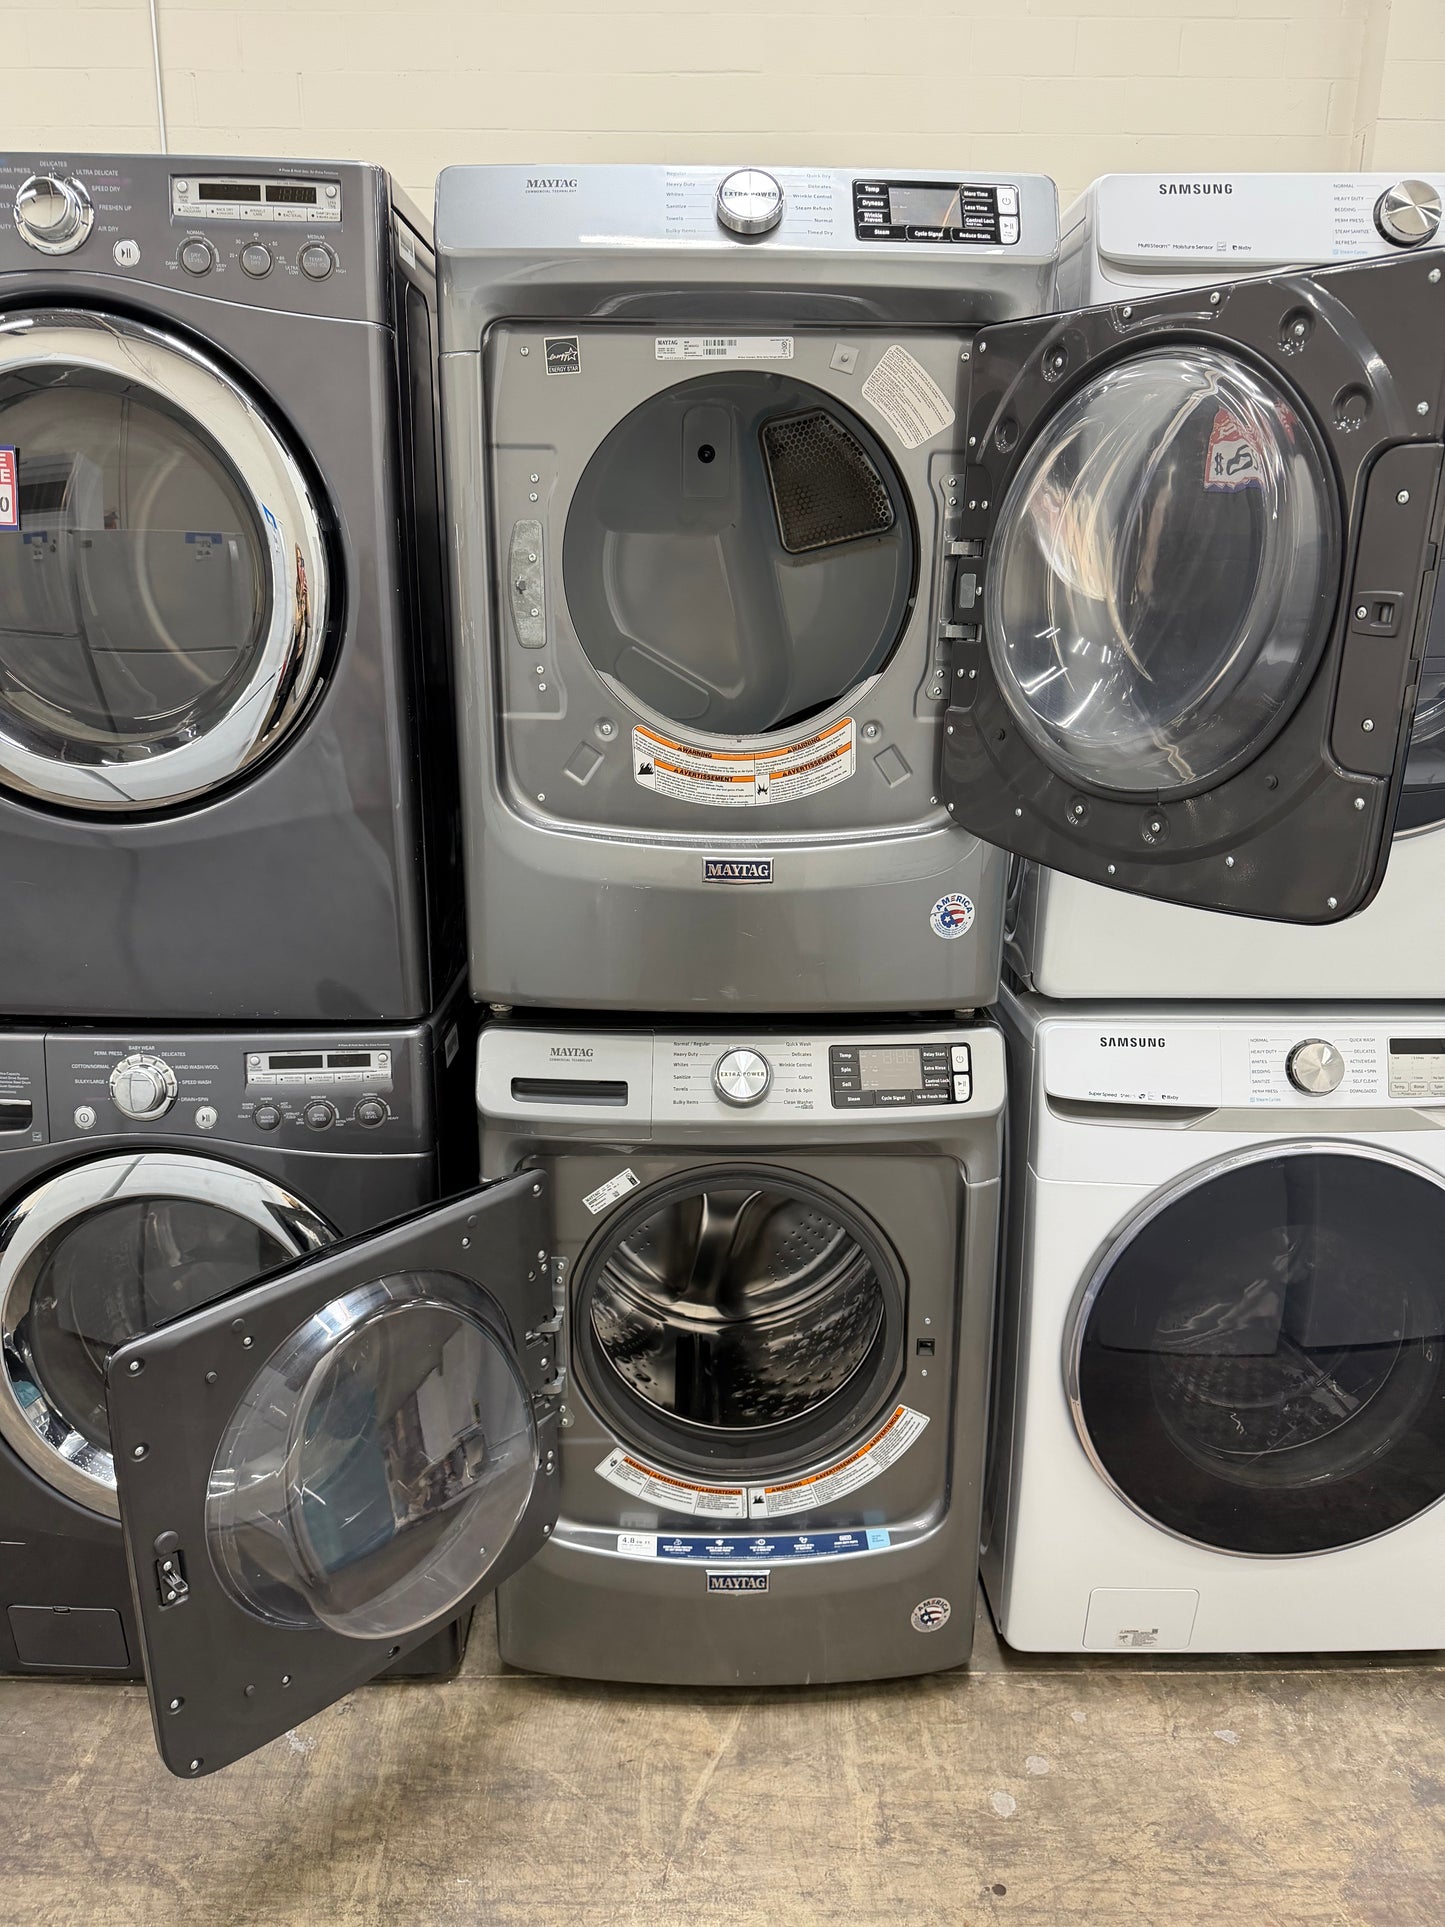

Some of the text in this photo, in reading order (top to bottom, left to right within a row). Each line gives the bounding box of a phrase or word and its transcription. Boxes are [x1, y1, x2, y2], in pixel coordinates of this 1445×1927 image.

[526, 179, 578, 188] MAYTAG
[1159, 183, 1233, 195] SAMSUNG
[914, 230, 943, 238] Cycle Signal
[791, 736, 821, 752] WARNING
[681, 746, 713, 759] WARNING
[787, 750, 839, 777] AVERTISSEMENT
[679, 769, 734, 783] AVERTISSEMENT
[707, 863, 769, 877] MAYTAG
[936, 895, 973, 914] AMERICA
[1100, 1037, 1166, 1048] SAMSUNG
[550, 1047, 594, 1057] MAYTAG
[705, 1487, 742, 1496] ADVERTENCIA
[711, 1577, 765, 1588] MAYTAG
[918, 1599, 949, 1613] AMERICA
